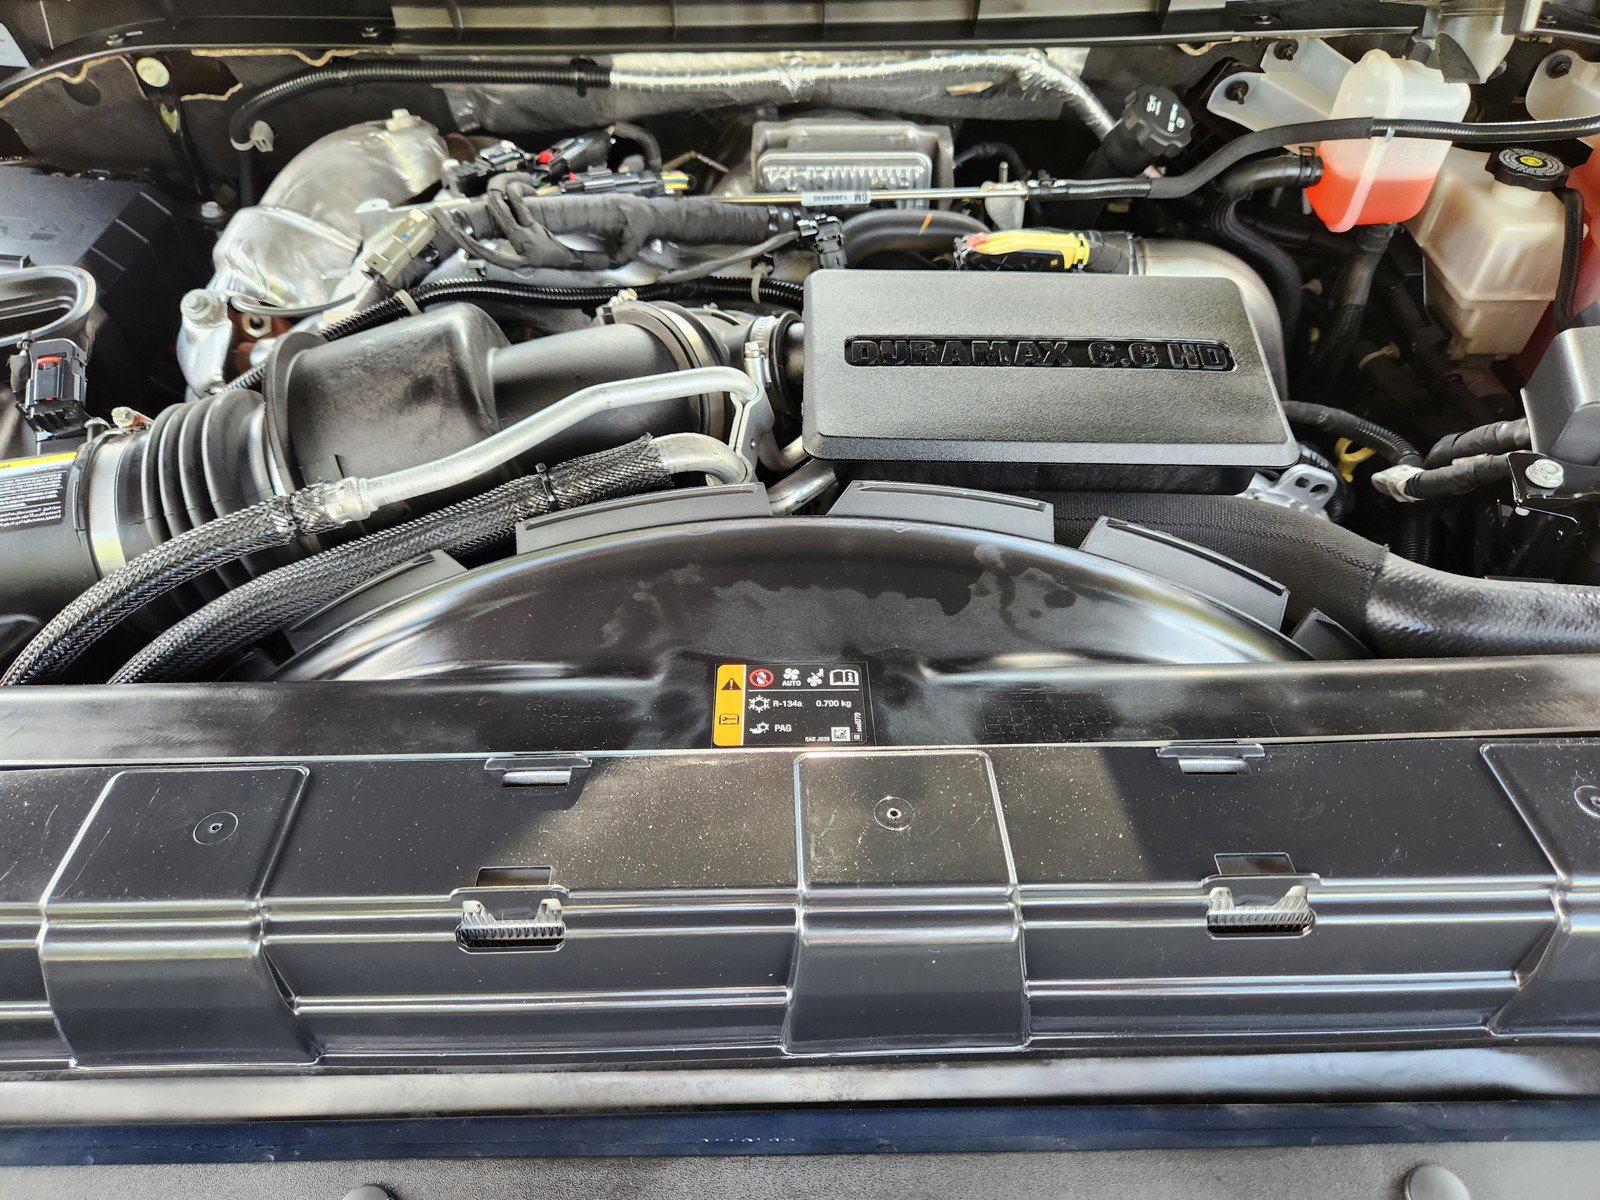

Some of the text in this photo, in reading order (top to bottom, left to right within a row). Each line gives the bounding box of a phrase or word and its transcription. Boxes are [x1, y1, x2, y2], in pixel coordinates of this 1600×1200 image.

[854, 192, 868, 203] GM
[851, 340, 1228, 370] DURAMAX 6.6 HD
[782, 679, 802, 687] AUTO
[773, 699, 852, 709] R-134a 0.700 kg
[774, 724, 792, 732] PAG
